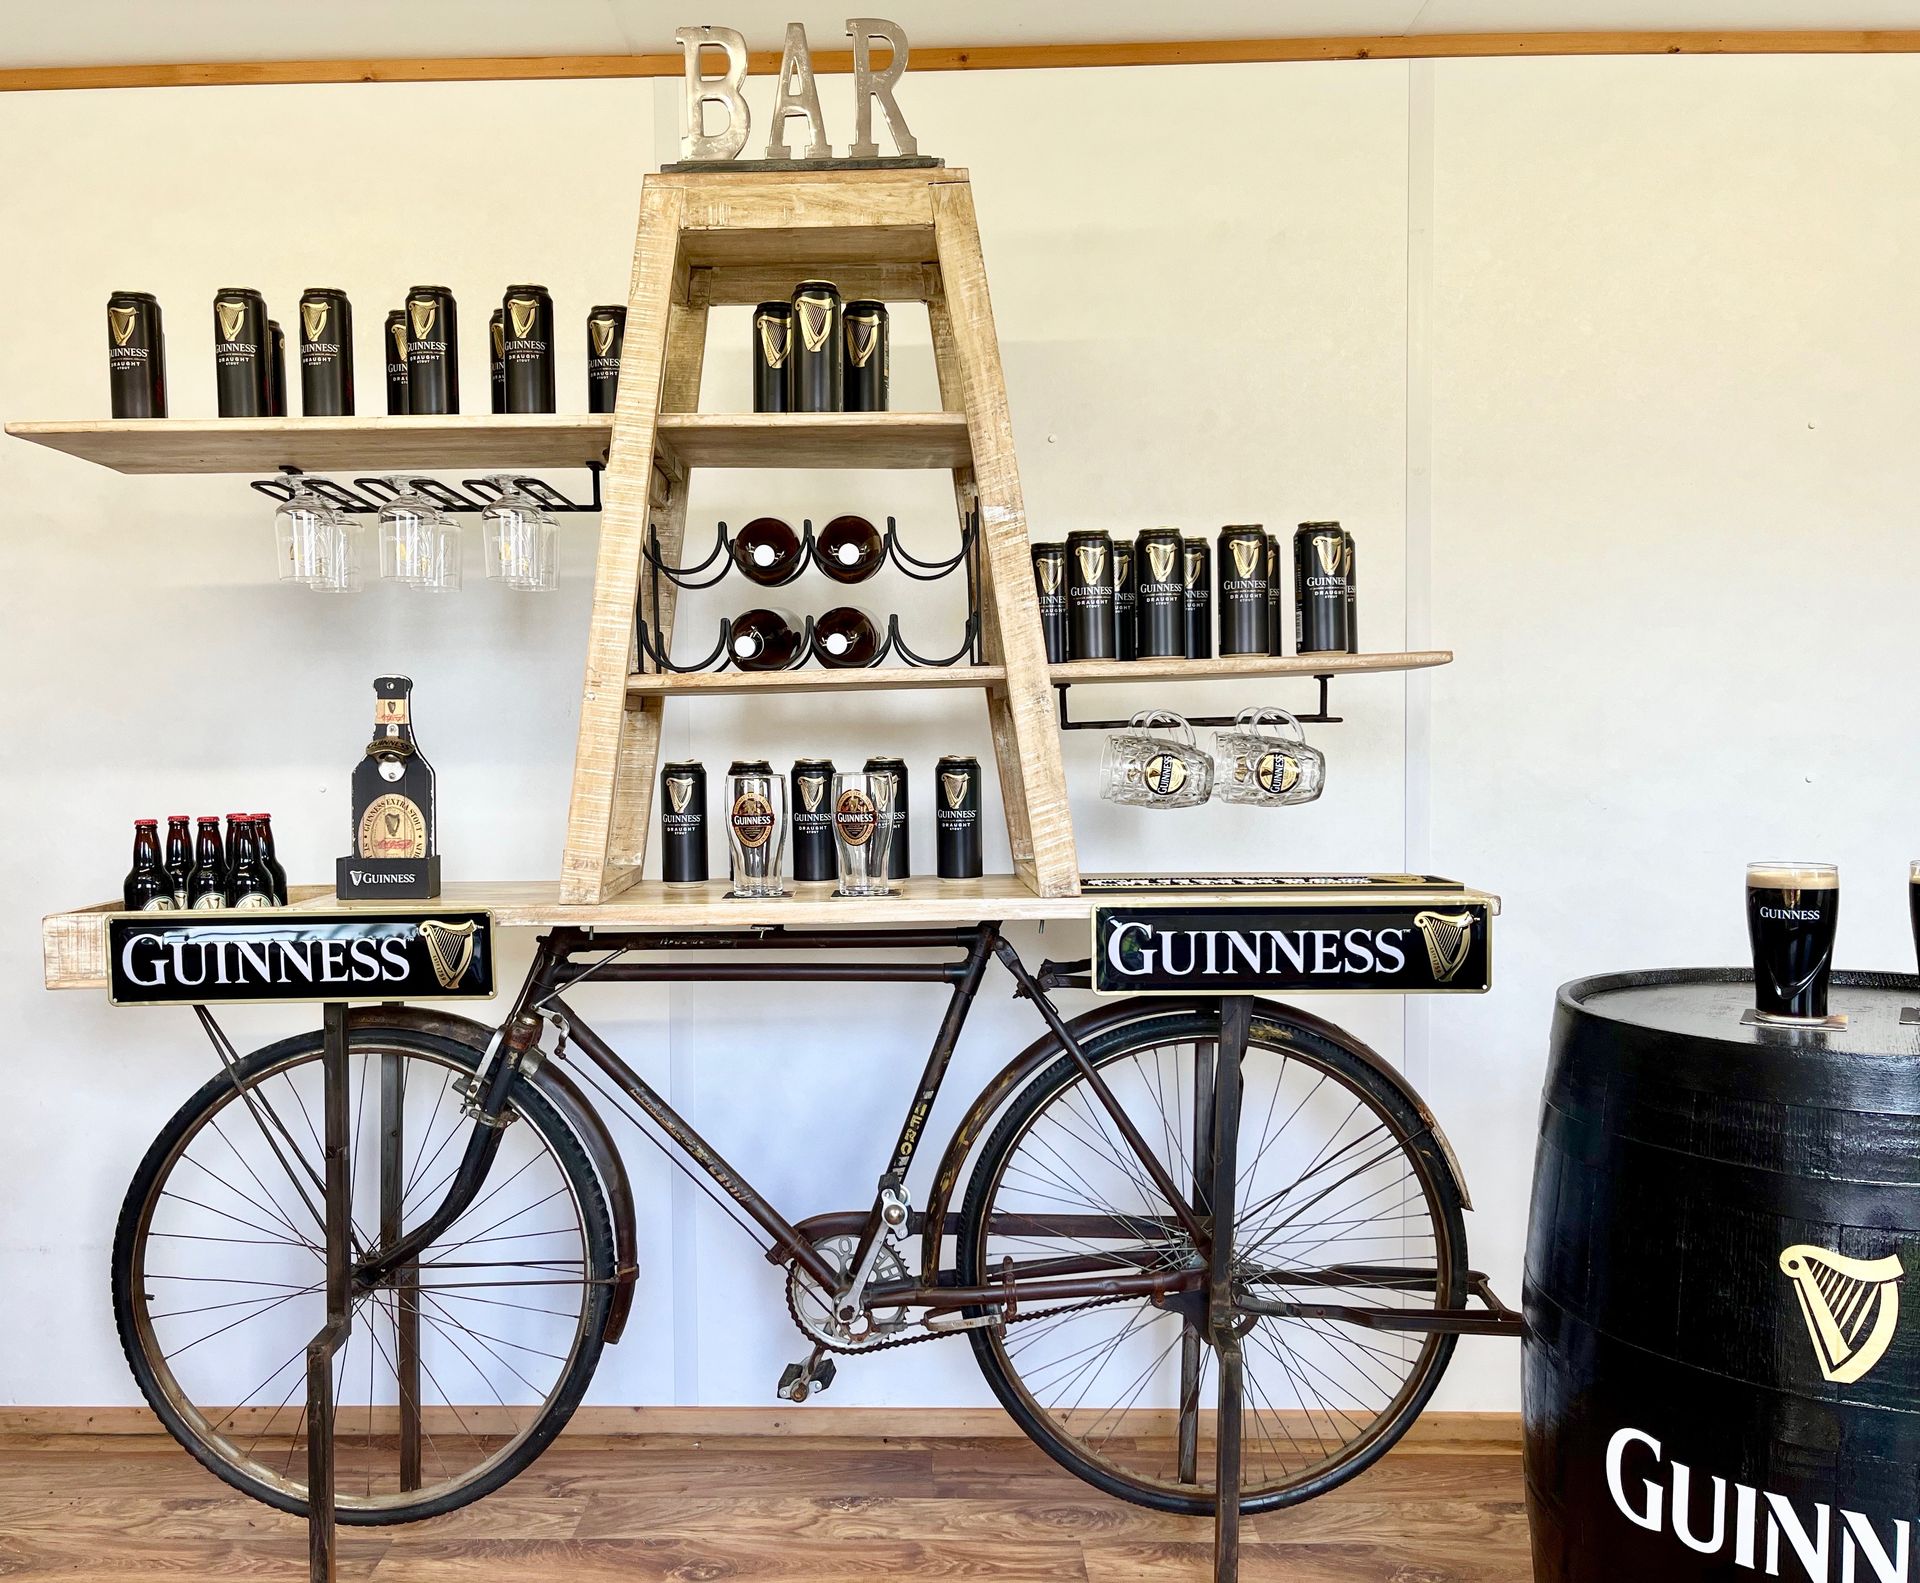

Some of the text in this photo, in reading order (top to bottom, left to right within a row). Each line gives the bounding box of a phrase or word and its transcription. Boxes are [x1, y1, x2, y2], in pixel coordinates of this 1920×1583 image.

[676, 18, 917, 160] BAR
[505, 341, 546, 350] GUINNESS
[110, 348, 148, 358] UINNESS
[388, 363, 408, 373] GUIN
[1140, 583, 1183, 594] GUINNESS
[1223, 580, 1267, 591] GUINNESS
[1070, 586, 1113, 597] GUINNESS
[1157, 755, 1173, 794] GUINNESS
[1270, 754, 1284, 793] GUINNESS
[386, 798, 410, 811] EXTRA
[662, 814, 702, 823] GUINNESS
[793, 812, 832, 822] GUINNESS
[837, 812, 874, 823] GUINNESS
[937, 809, 976, 819] GUINNESS
[734, 815, 771, 826] GUINNESS
[362, 872, 416, 884] GUINNESS
[1760, 906, 1820, 920] GUINNESS
[1107, 920, 1406, 976] GUINNESS
[121, 933, 411, 987] GUINNESS
[1605, 1427, 1911, 1583] GUINN
